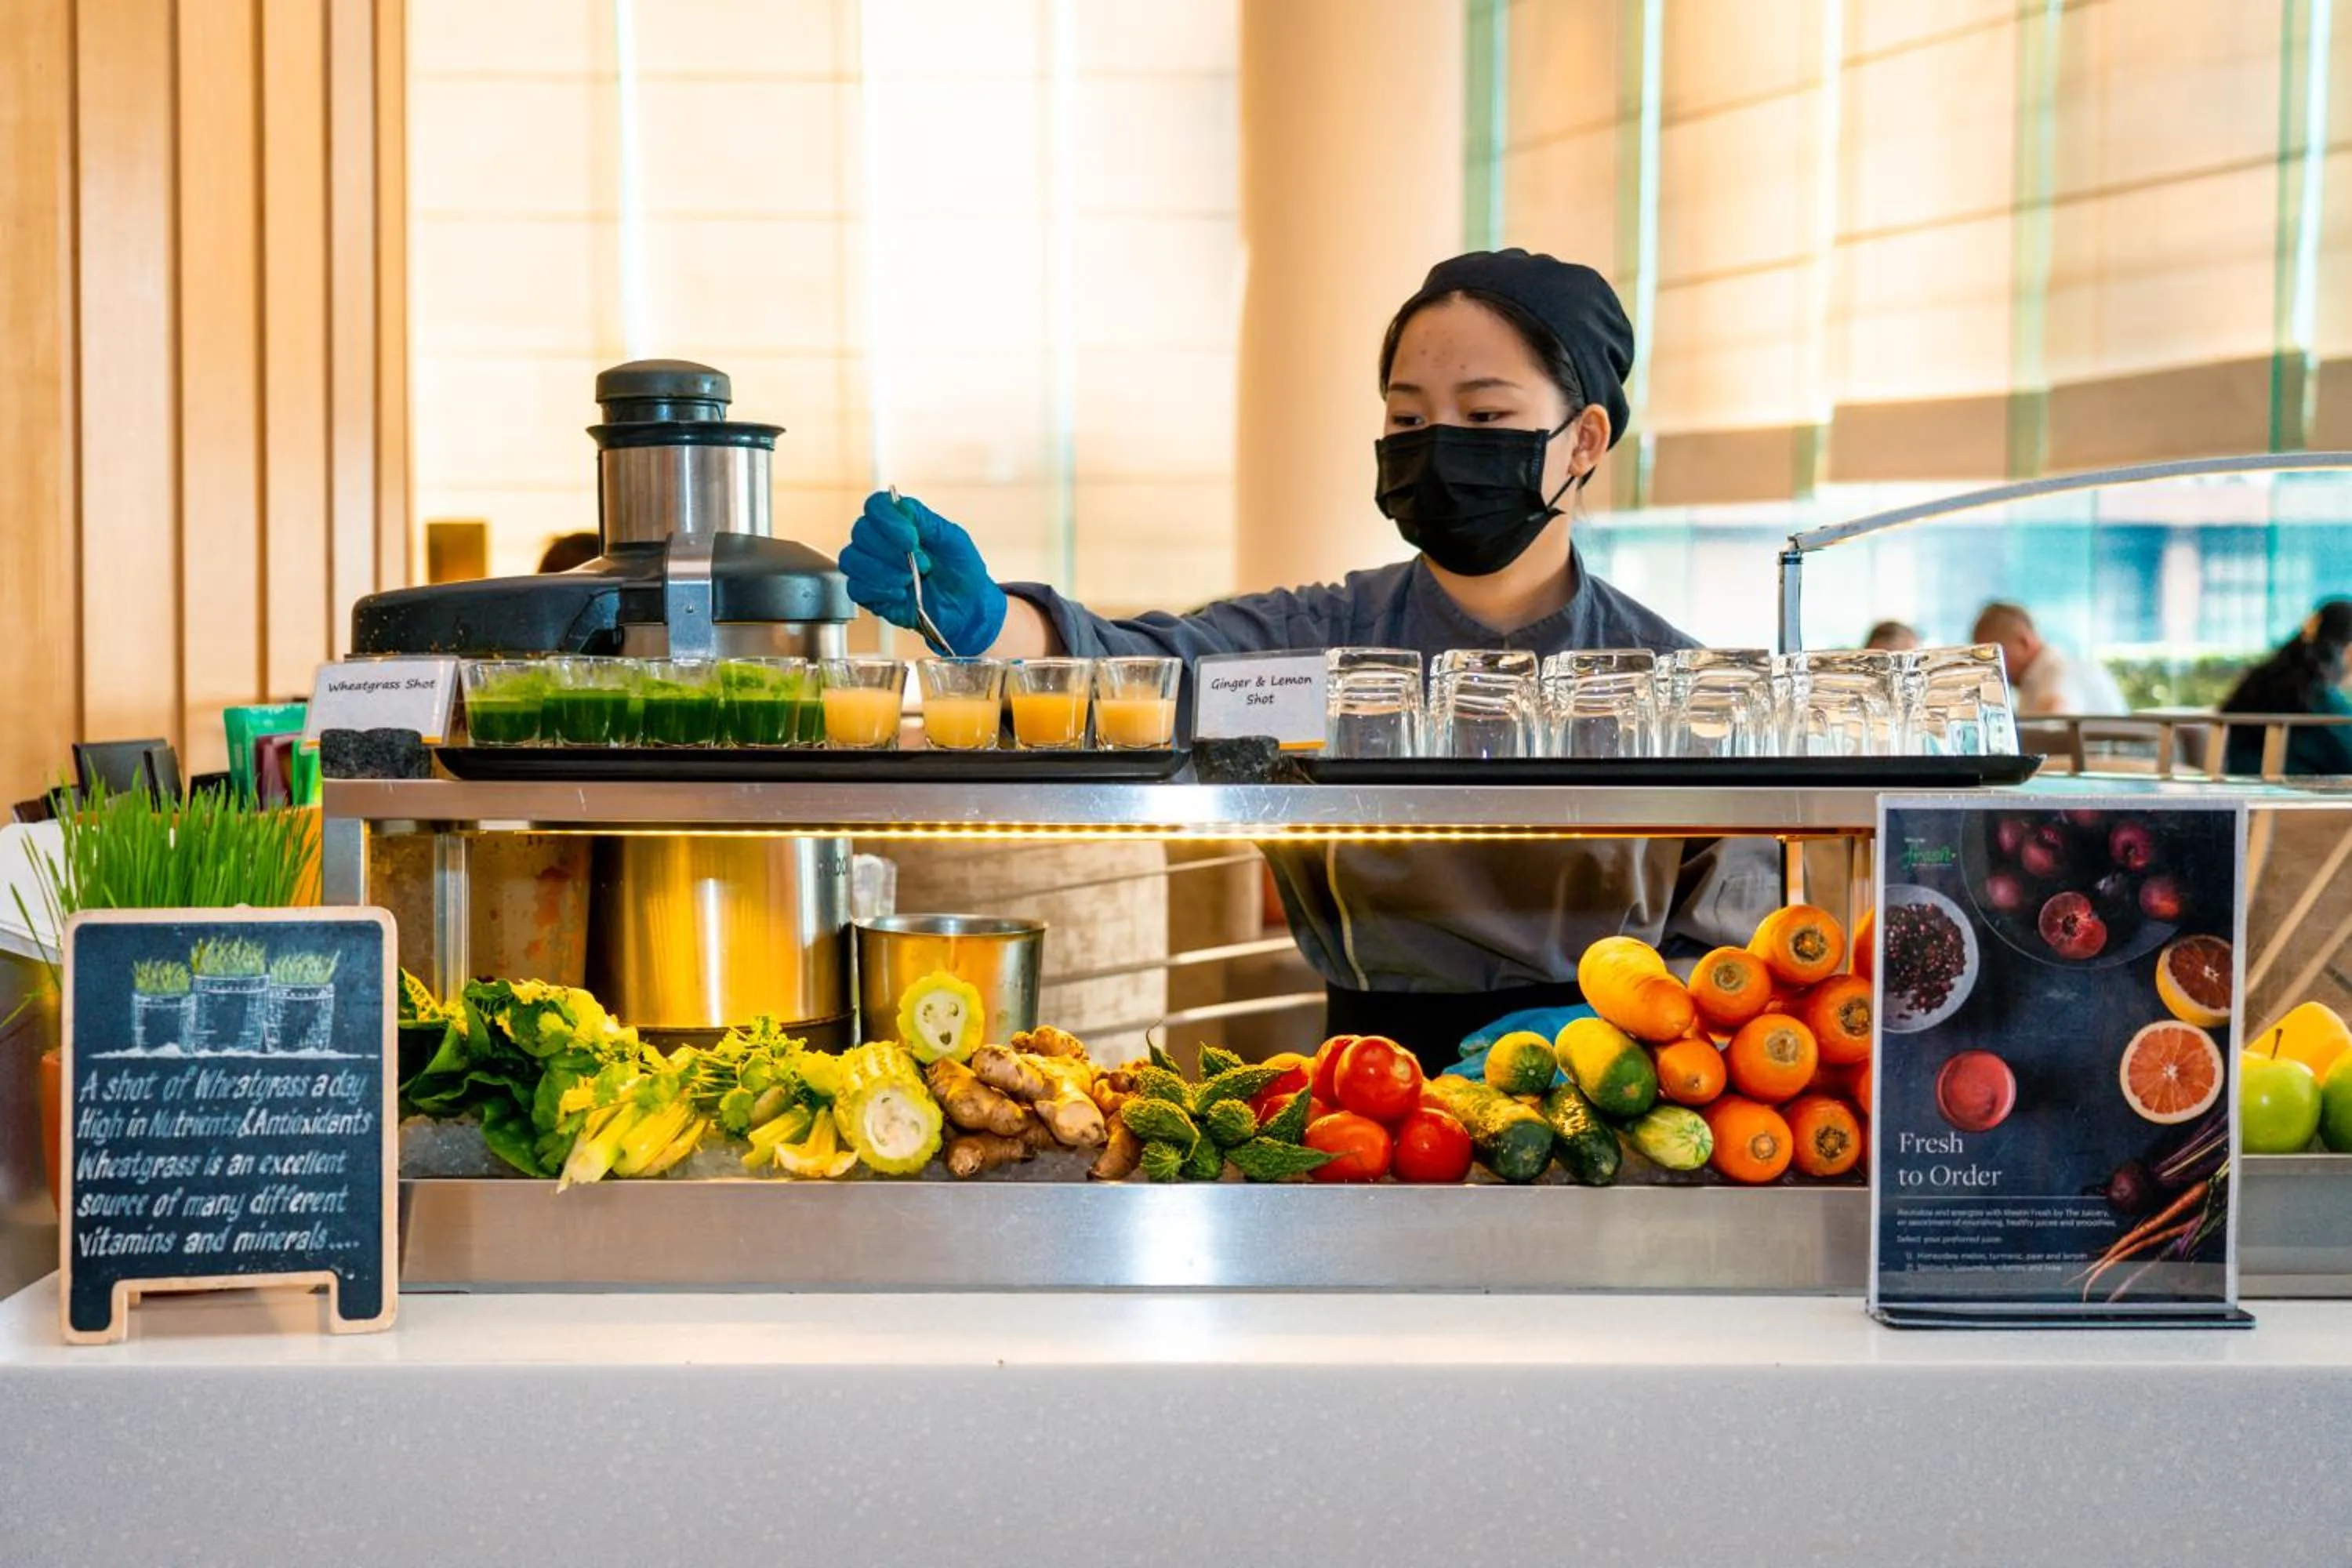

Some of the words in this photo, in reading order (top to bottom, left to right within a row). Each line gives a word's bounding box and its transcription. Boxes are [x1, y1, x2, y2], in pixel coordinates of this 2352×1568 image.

[328, 679, 401, 694] Wheatgrass
[405, 677, 436, 690] Shot
[1210, 677, 1252, 692] Ginger
[1255, 675, 1266, 688] &
[1270, 674, 1312, 687] Lemon
[1246, 693, 1276, 706] Shot
[78, 1069, 99, 1103] A
[102, 1069, 159, 1102] shot
[162, 1065, 198, 1101] of
[194, 1068, 310, 1105] Wheatgrass
[311, 1073, 329, 1098] a
[328, 1069, 369, 1105] day
[77, 1106, 124, 1146] High
[126, 1107, 149, 1138] in
[1898, 1132, 1964, 1154] Fresh
[77, 1148, 202, 1185] Wheatgrass
[203, 1146, 224, 1176] is
[227, 1153, 255, 1177] an
[258, 1149, 348, 1176] excellent
[1897, 1167, 1923, 1187] to
[1929, 1163, 2002, 1187] Order
[77, 1193, 150, 1218] source
[152, 1186, 184, 1218] of
[181, 1192, 246, 1223] many
[249, 1183, 350, 1215] different
[78, 1224, 179, 1258] vitamins
[183, 1225, 233, 1254] and
